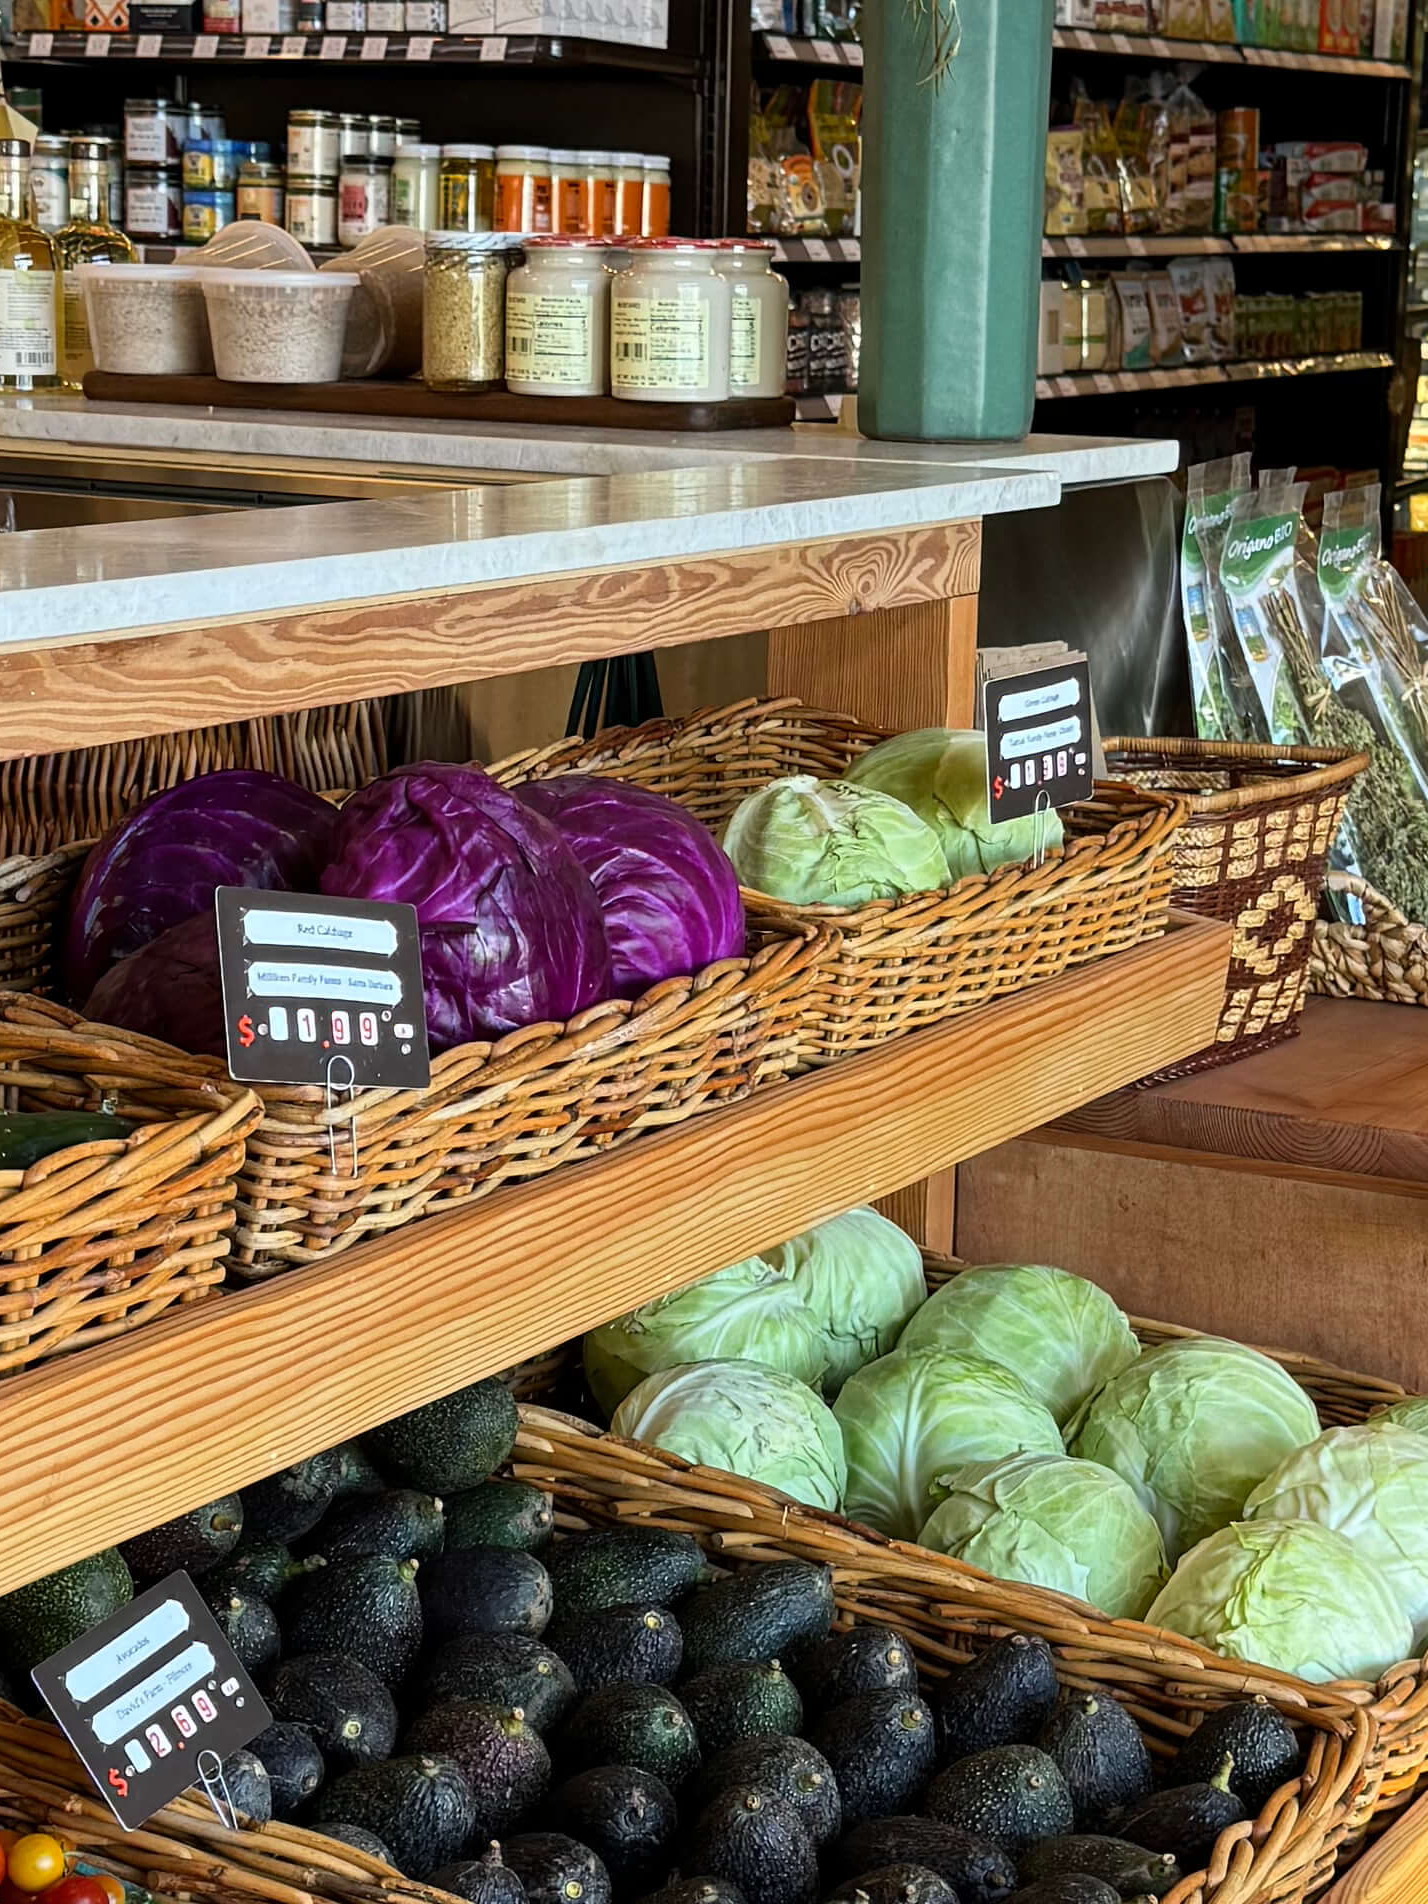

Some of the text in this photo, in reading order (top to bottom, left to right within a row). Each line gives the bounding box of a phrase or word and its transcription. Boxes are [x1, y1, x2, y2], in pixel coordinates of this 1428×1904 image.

[1228, 520, 1294, 561] Origano BIO
[1321, 543, 1359, 569] Origano
